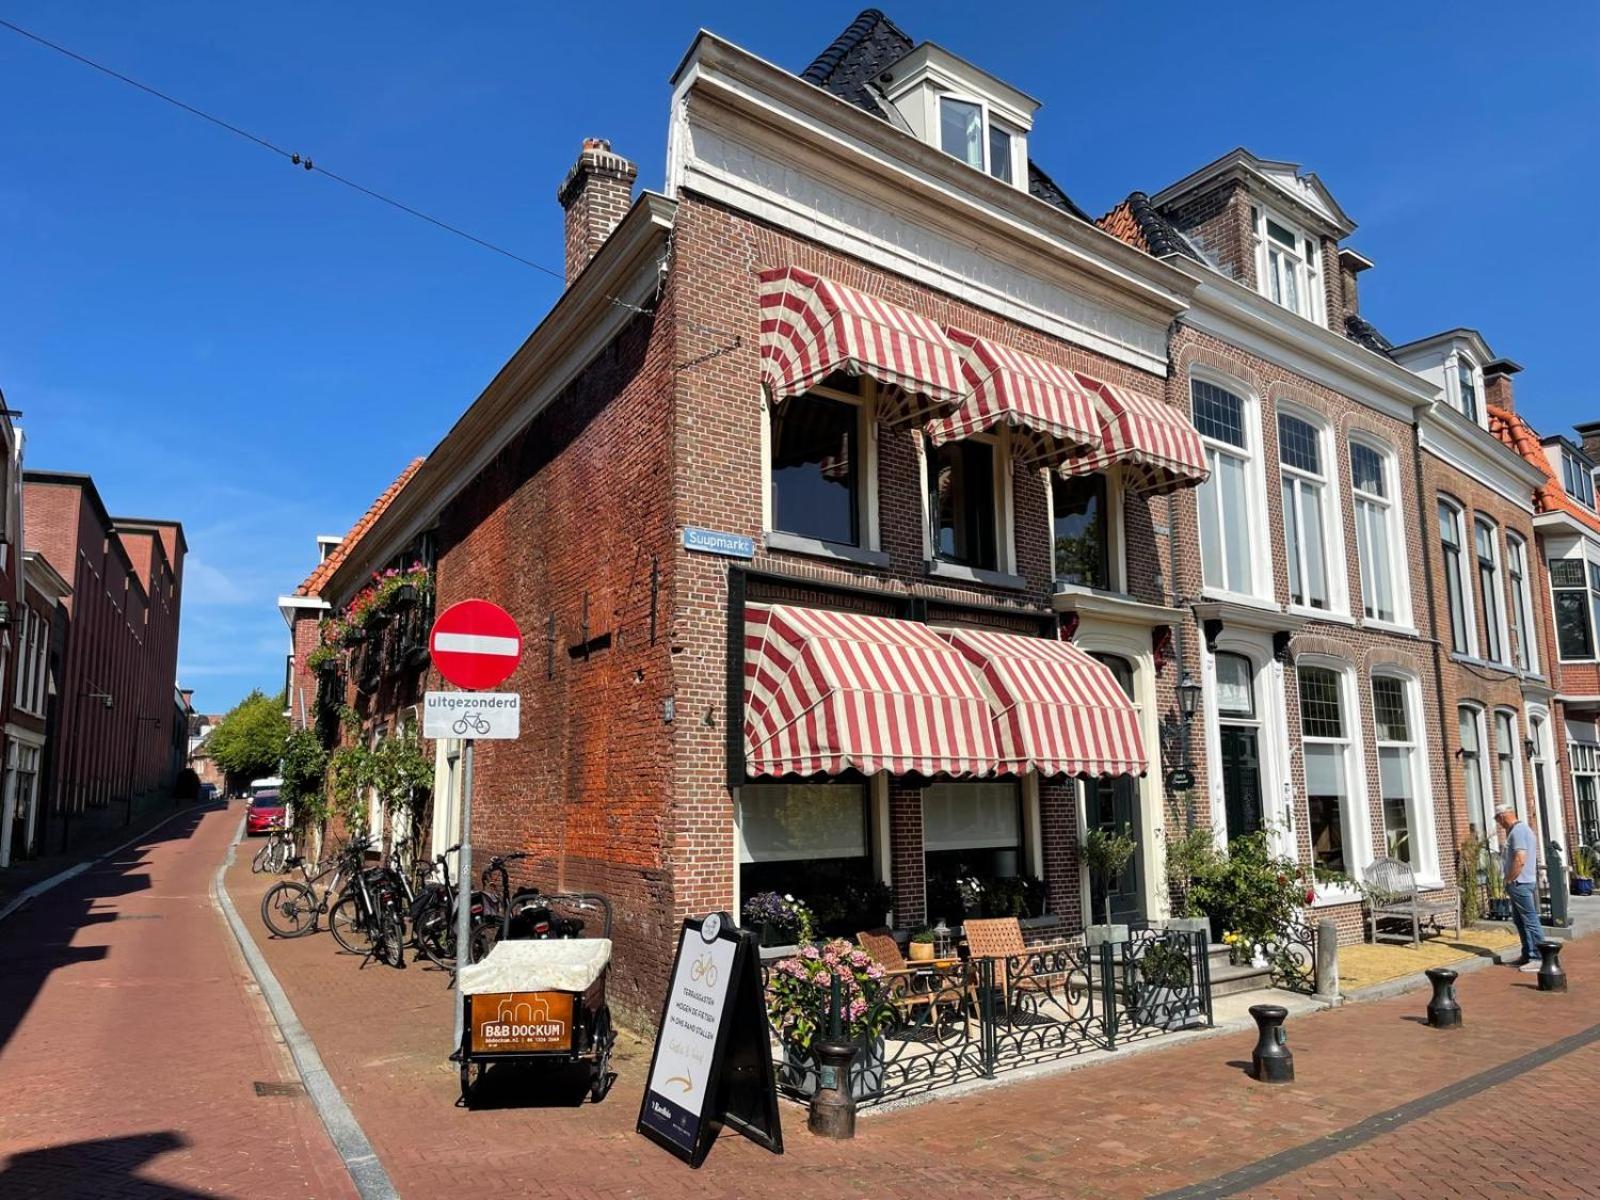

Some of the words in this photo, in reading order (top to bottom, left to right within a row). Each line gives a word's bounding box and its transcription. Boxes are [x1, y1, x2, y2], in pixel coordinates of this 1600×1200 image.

[428, 696, 517, 710] uitgezonderd
[485, 1025, 510, 1037] B&B
[512, 1024, 560, 1036] DOCKUM
